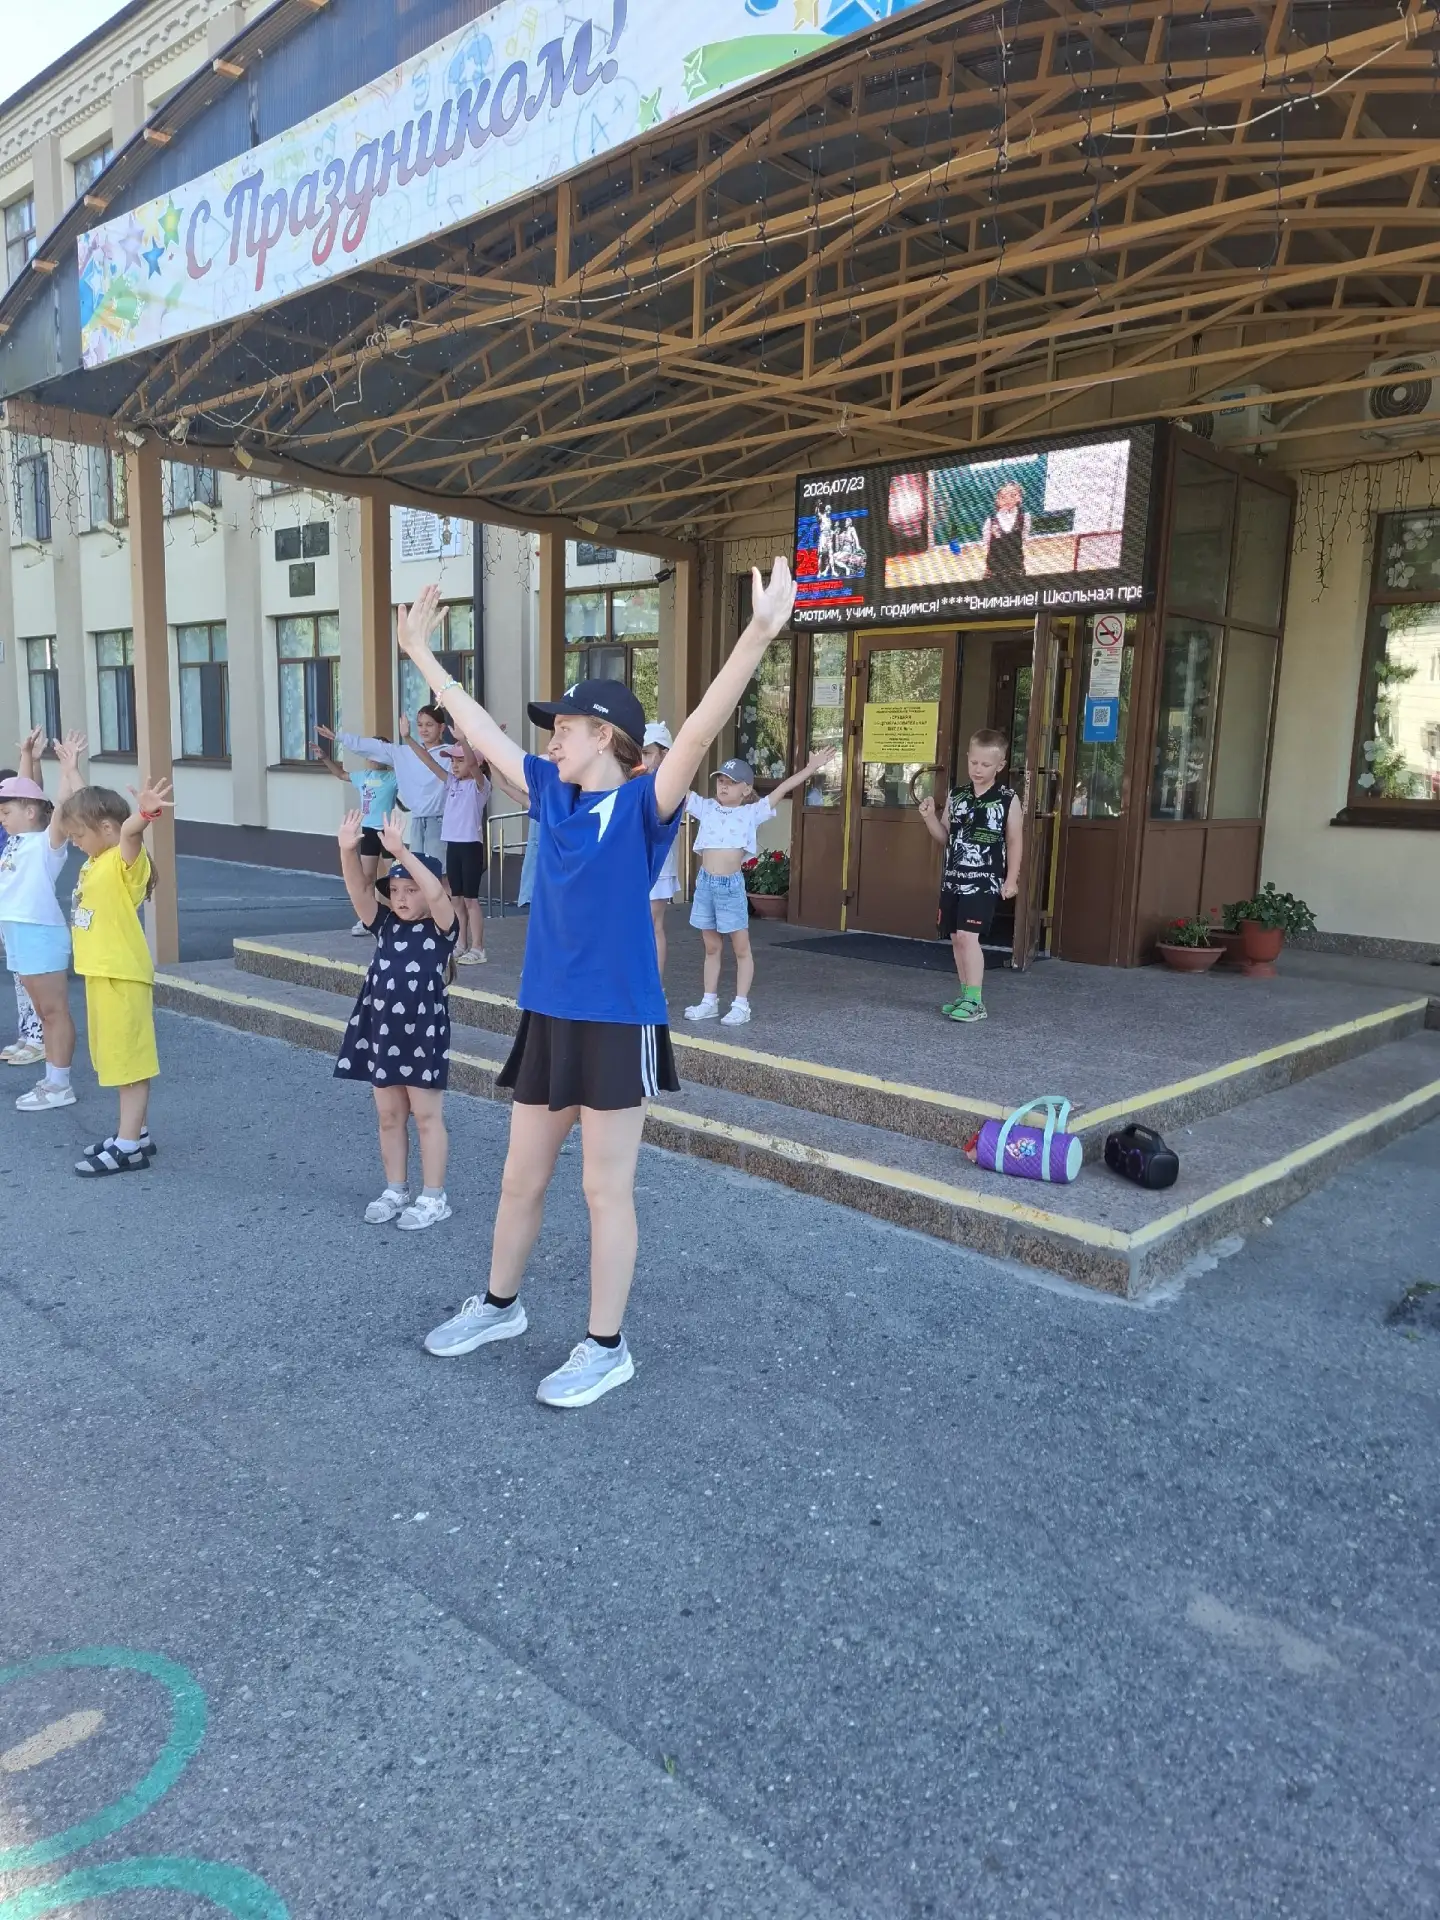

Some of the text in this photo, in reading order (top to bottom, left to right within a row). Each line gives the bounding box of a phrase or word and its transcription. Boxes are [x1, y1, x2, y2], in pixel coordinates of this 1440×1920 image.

[186, 0, 628, 292] С Праздником!
[803, 476, 865, 498] 2026/07/23
[845, 607, 877, 621] учим,
[880, 599, 940, 620] гордимся!
[1043, 587, 1114, 606] Школьная
